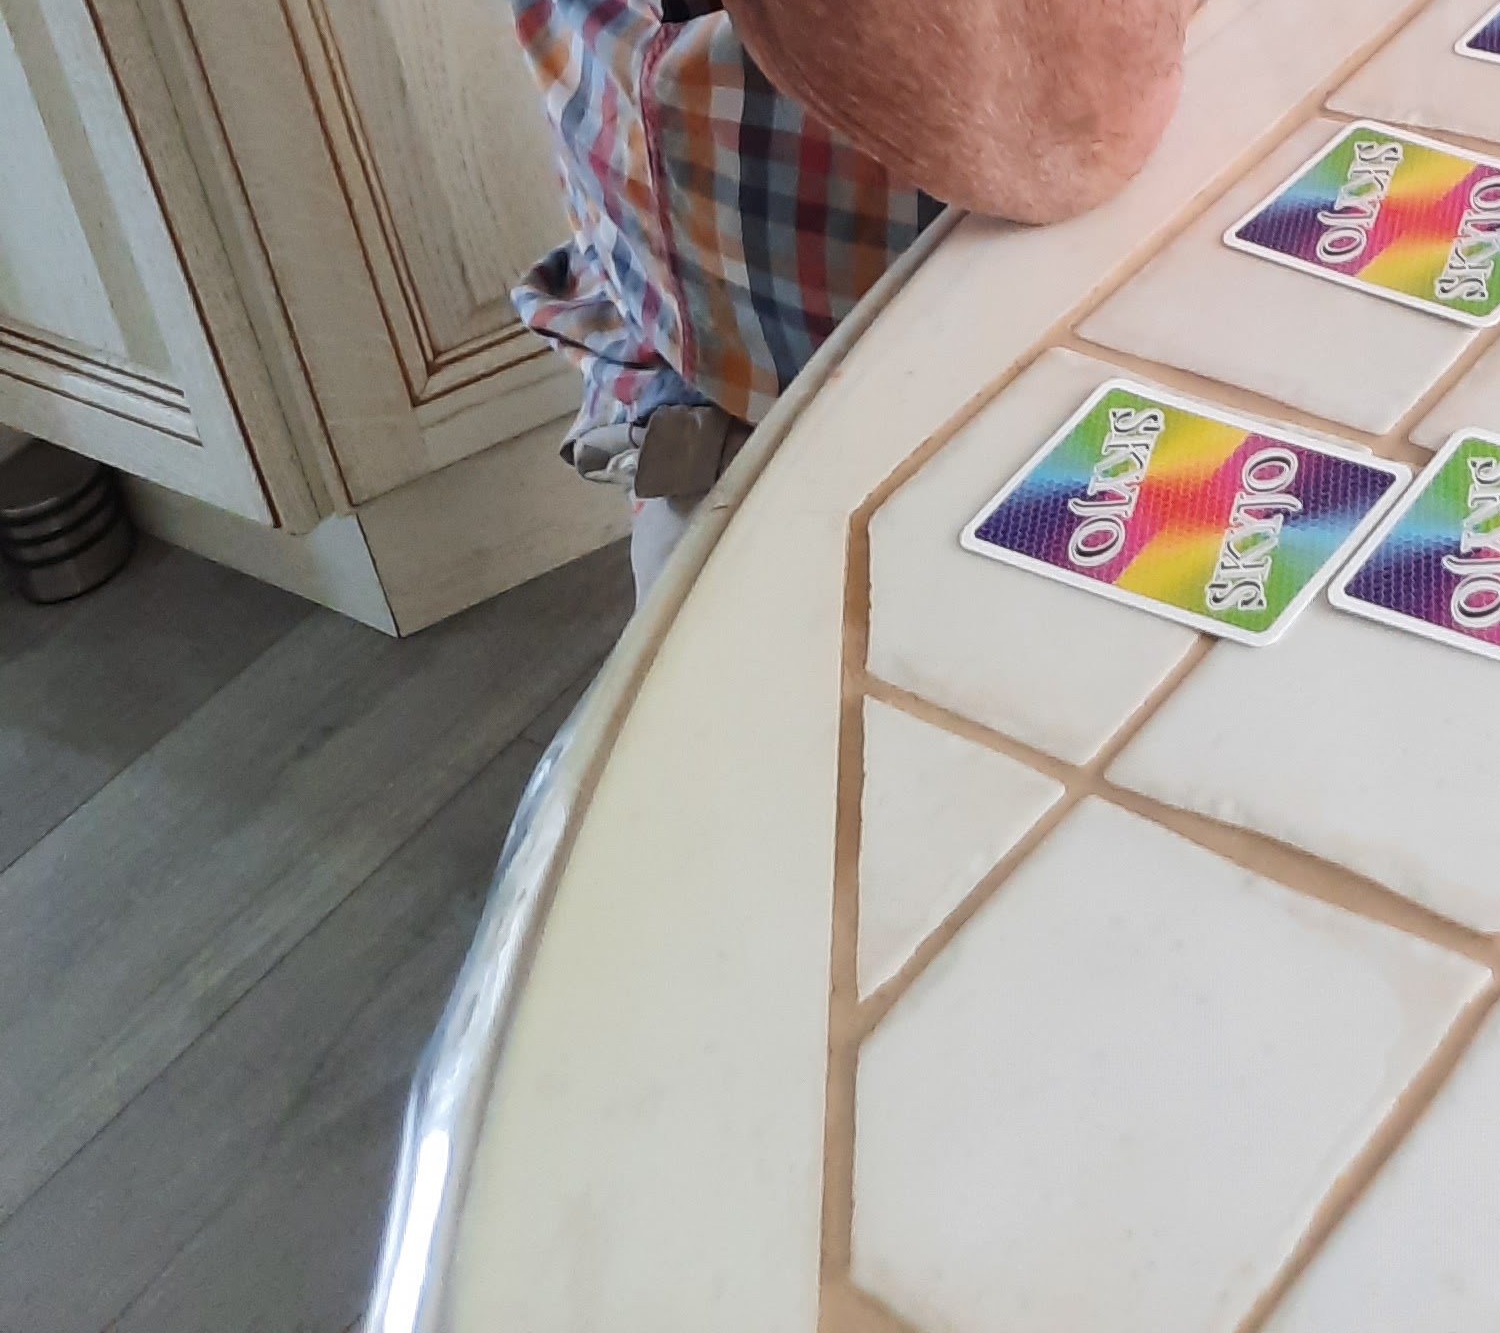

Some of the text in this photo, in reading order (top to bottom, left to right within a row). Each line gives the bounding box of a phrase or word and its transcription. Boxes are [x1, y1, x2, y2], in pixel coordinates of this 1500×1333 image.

[1315, 141, 1403, 264] SKYJO
[1068, 407, 1165, 566] SKYJO
[1205, 447, 1303, 611] SKYJO
